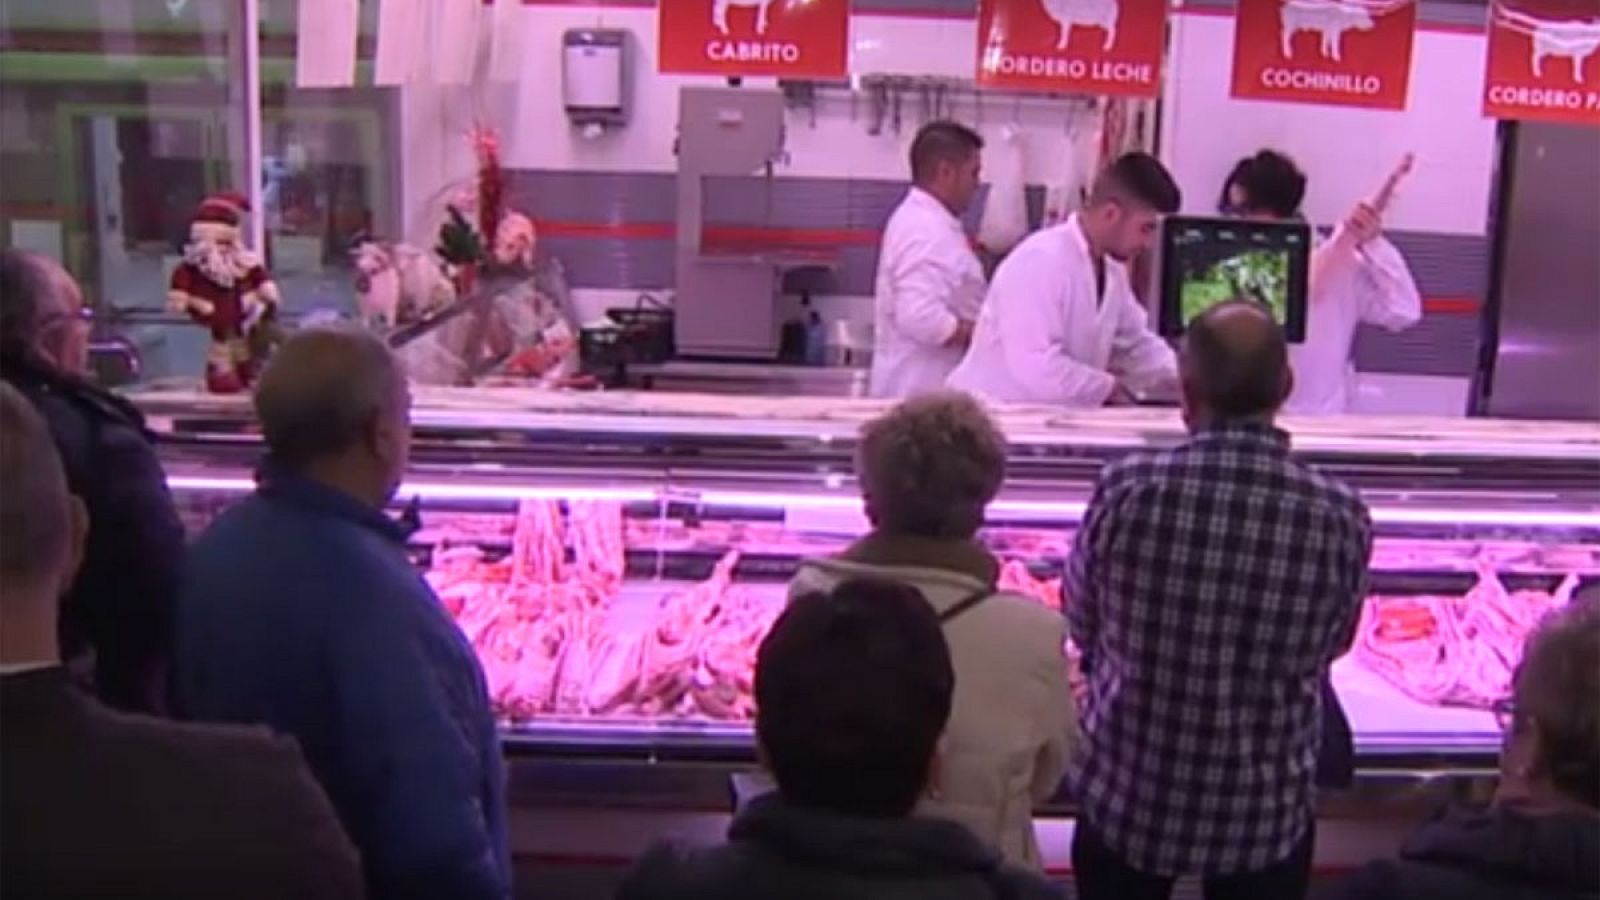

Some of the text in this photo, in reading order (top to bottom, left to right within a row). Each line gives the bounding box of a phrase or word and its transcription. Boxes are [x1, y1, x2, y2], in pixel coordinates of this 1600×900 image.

[706, 40, 799, 63] CABRITO
[983, 54, 1152, 83] ORDERO LECHE
[1261, 66, 1381, 95] COCHINILLO
[1488, 85, 1583, 109] CORDERO
